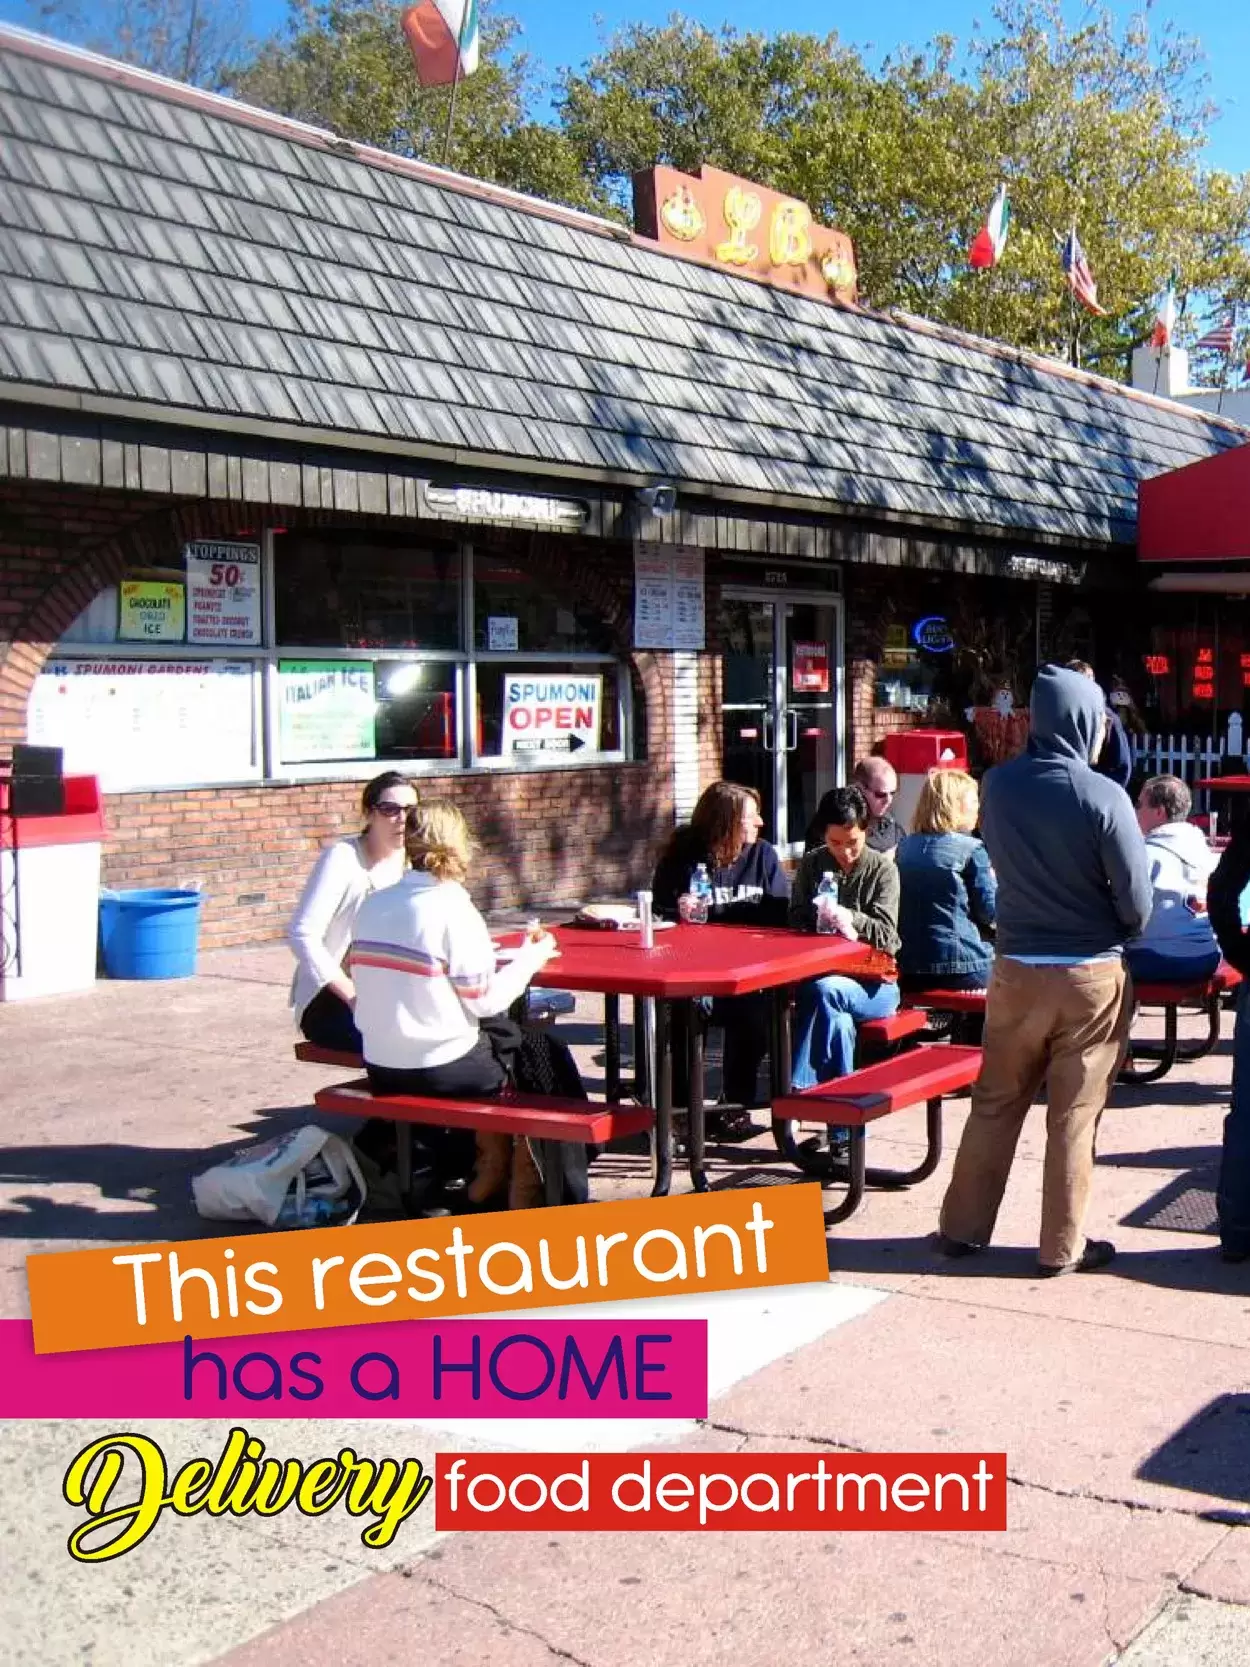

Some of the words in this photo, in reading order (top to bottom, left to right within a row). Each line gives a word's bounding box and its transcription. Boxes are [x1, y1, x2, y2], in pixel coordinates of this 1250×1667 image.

[194, 544, 259, 563] TOPPINGS
[143, 623, 161, 634] ICE
[74, 663, 143, 676] SPUMONI
[341, 667, 368, 693] ICE
[509, 683, 596, 702] SPUMONI
[509, 707, 593, 730] OPEN
